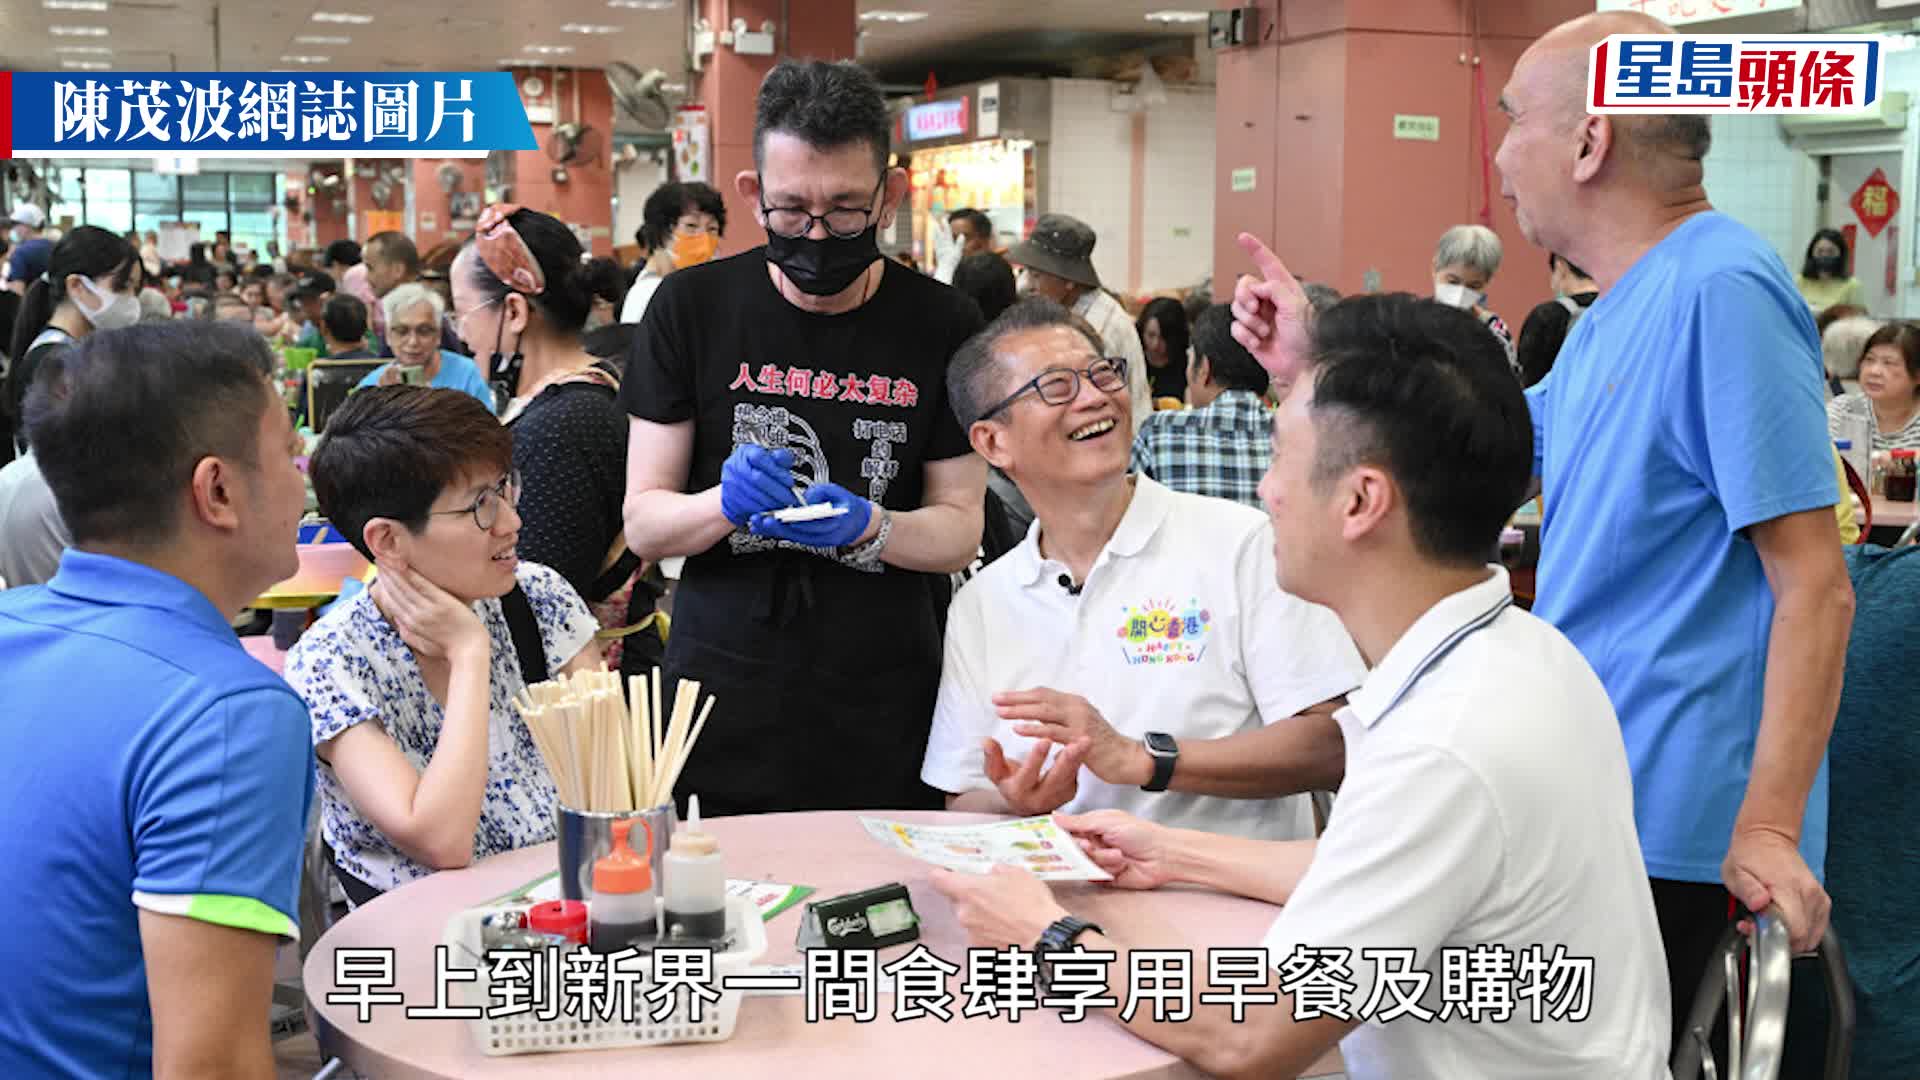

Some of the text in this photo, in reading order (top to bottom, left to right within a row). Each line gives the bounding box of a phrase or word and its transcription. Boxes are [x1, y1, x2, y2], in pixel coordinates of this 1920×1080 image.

[1862, 185, 1888, 216] 福
[729, 362, 919, 407] 人生何必太复杂
[852, 418, 908, 443] 打电话
